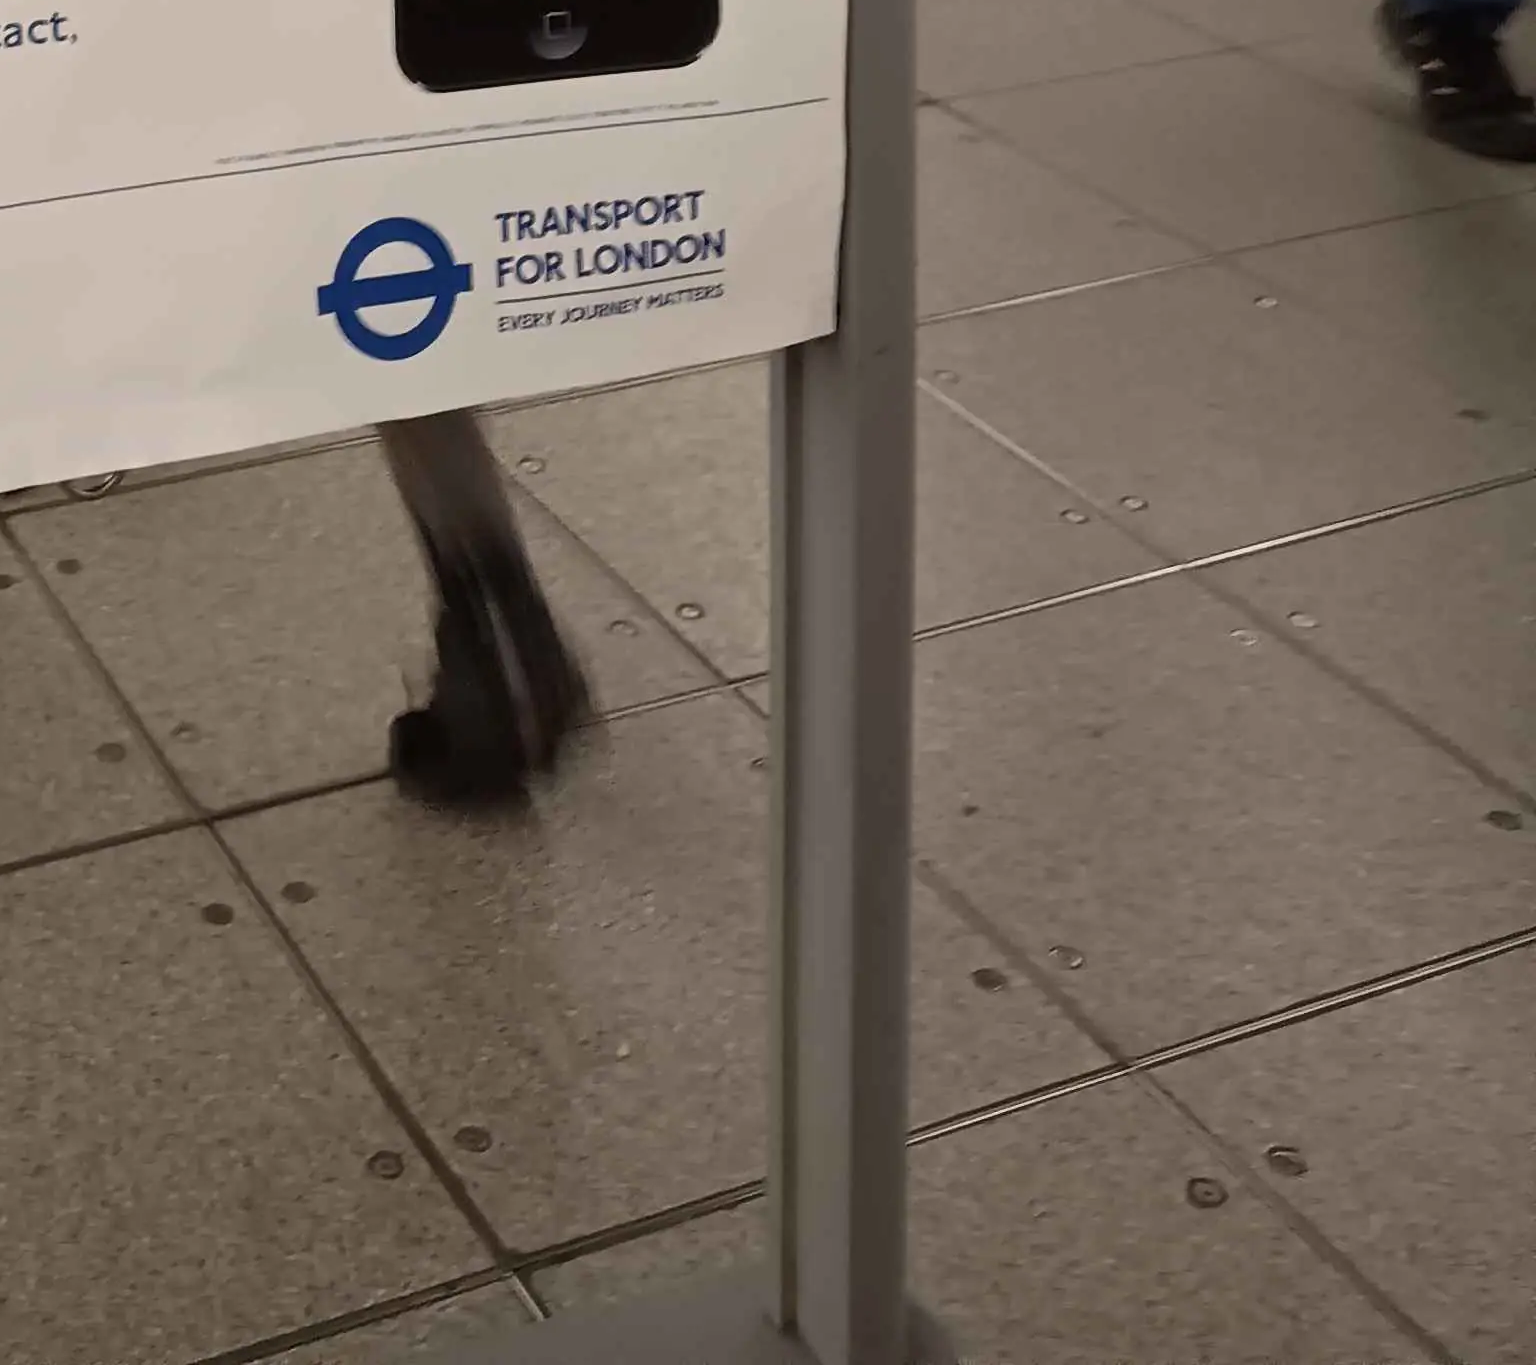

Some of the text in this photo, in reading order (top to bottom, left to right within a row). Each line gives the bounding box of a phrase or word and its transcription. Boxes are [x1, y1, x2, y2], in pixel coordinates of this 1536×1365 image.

[494, 190, 705, 243] TRANSPORT
[496, 229, 725, 288] FOR LONDON
[497, 283, 724, 333] EVERY JOURNEY MATTERS
